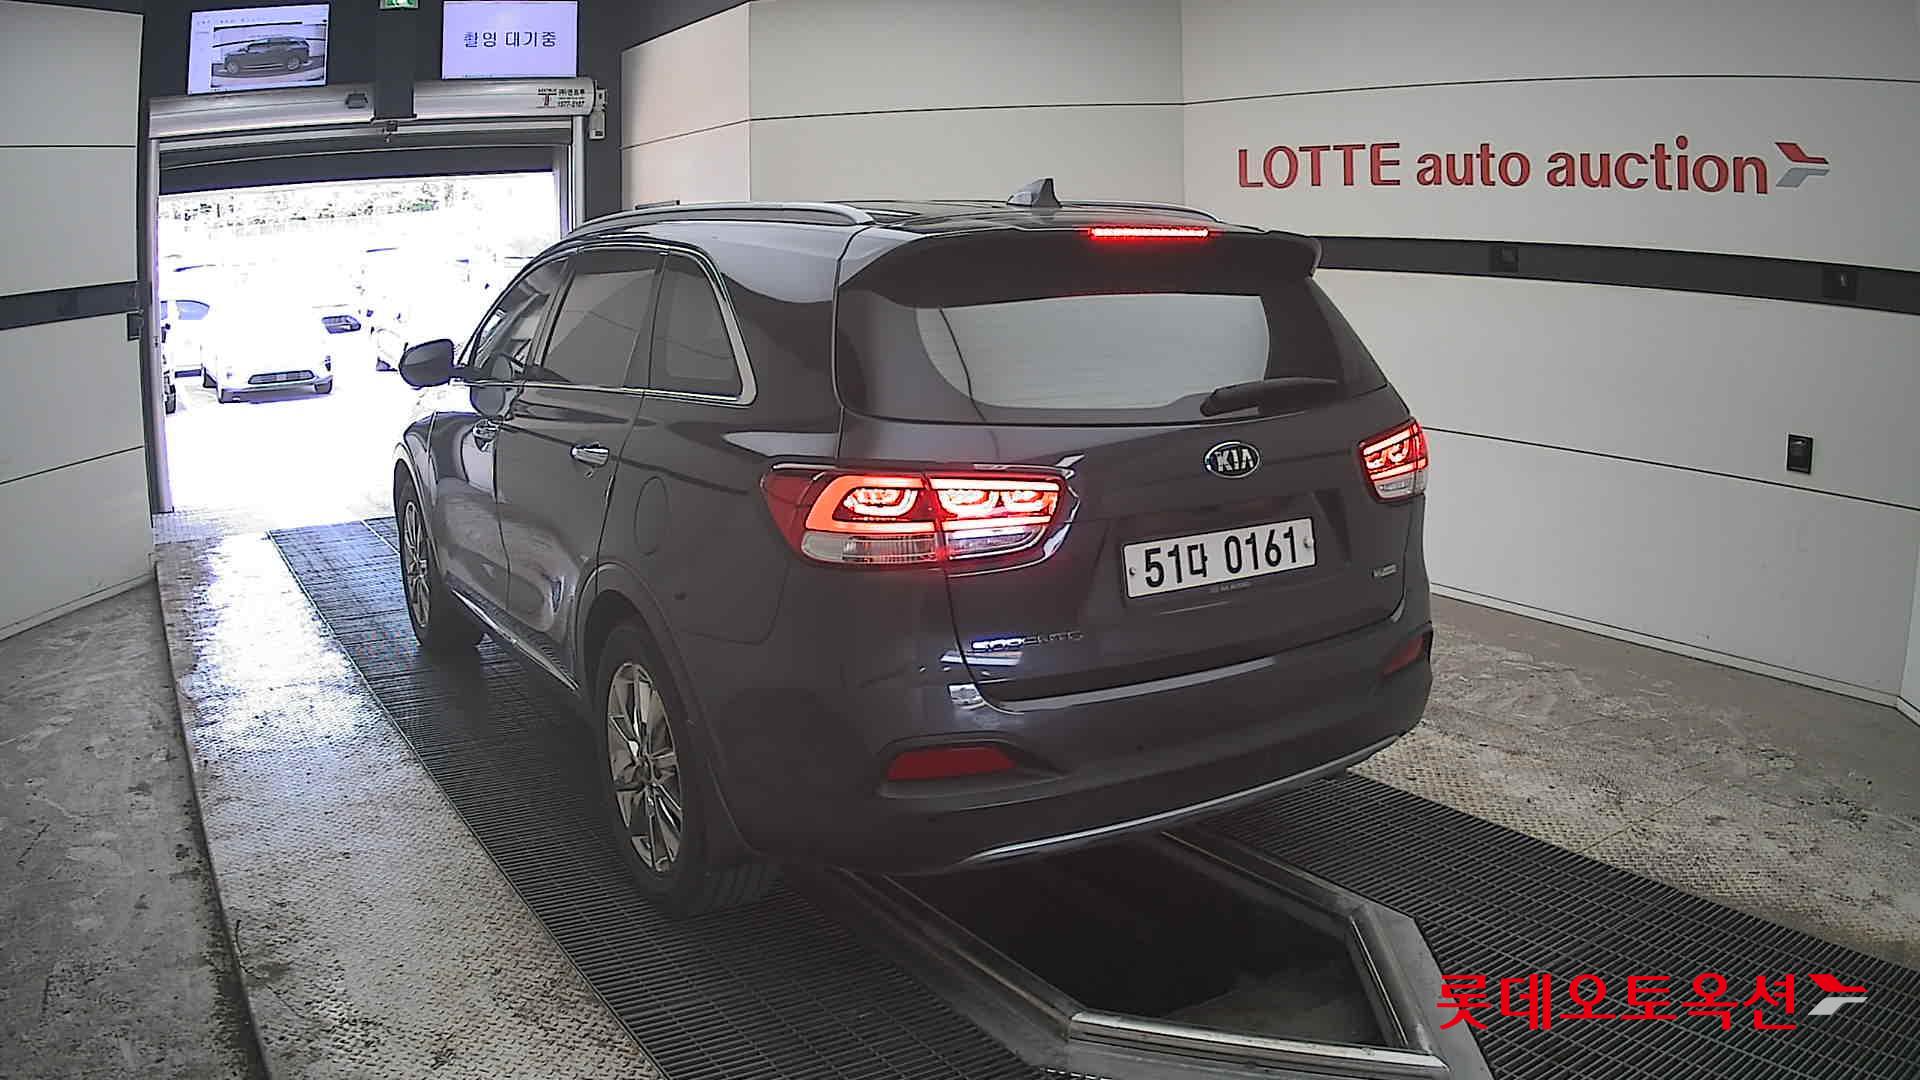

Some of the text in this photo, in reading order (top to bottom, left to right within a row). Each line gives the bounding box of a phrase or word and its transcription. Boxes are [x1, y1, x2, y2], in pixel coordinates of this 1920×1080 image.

[505, 31, 556, 48] 대기중
[1238, 135, 1768, 194] LOTTE auto auction
[1213, 448, 1254, 472] KIA
[1145, 526, 1297, 588] 51다 0161
